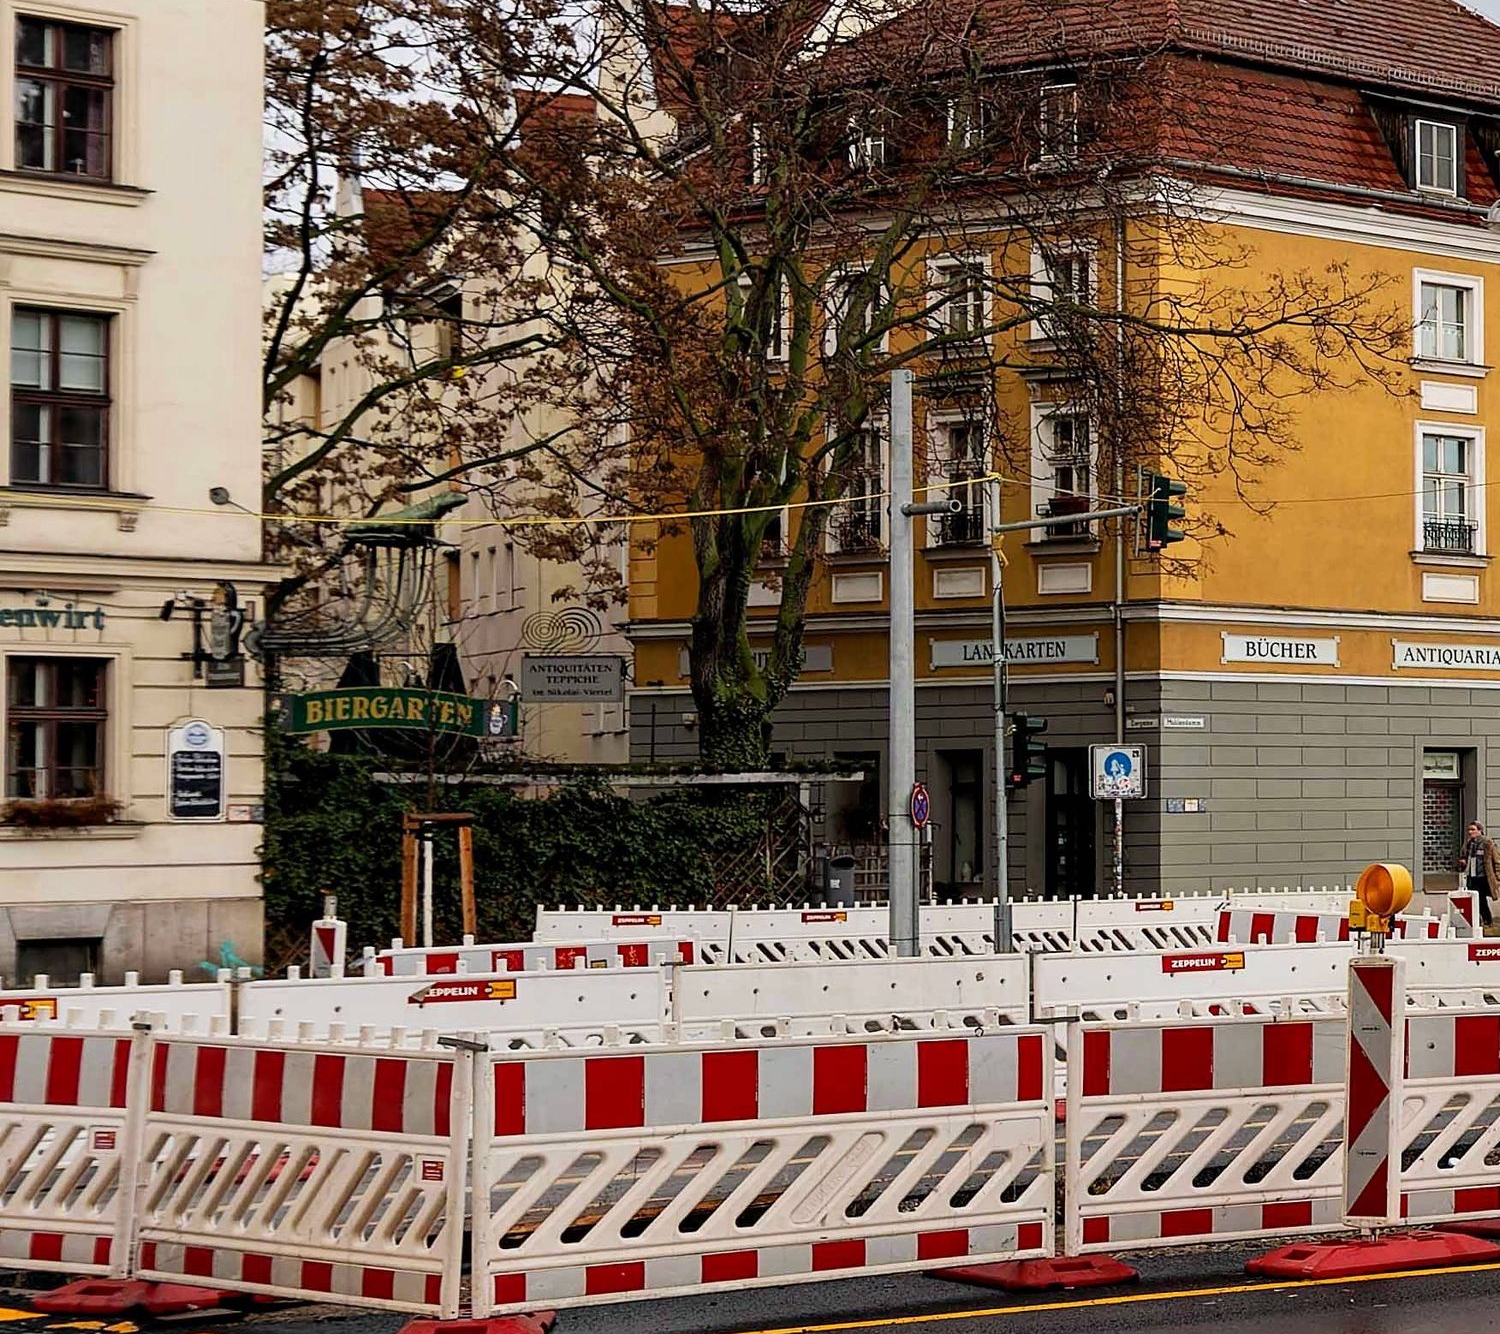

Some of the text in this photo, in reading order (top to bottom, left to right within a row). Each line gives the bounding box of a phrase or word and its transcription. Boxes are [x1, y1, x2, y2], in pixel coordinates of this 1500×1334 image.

[962, 640, 1067, 662] LANKARTEN
[1245, 637, 1318, 660] BÜCHER
[529, 662, 613, 674] ANTIQUITÄTEN
[546, 675, 600, 685] TEPPICHE
[306, 694, 475, 726] BIERGARTEN
[1170, 957, 1216, 968] ZEPPELIN
